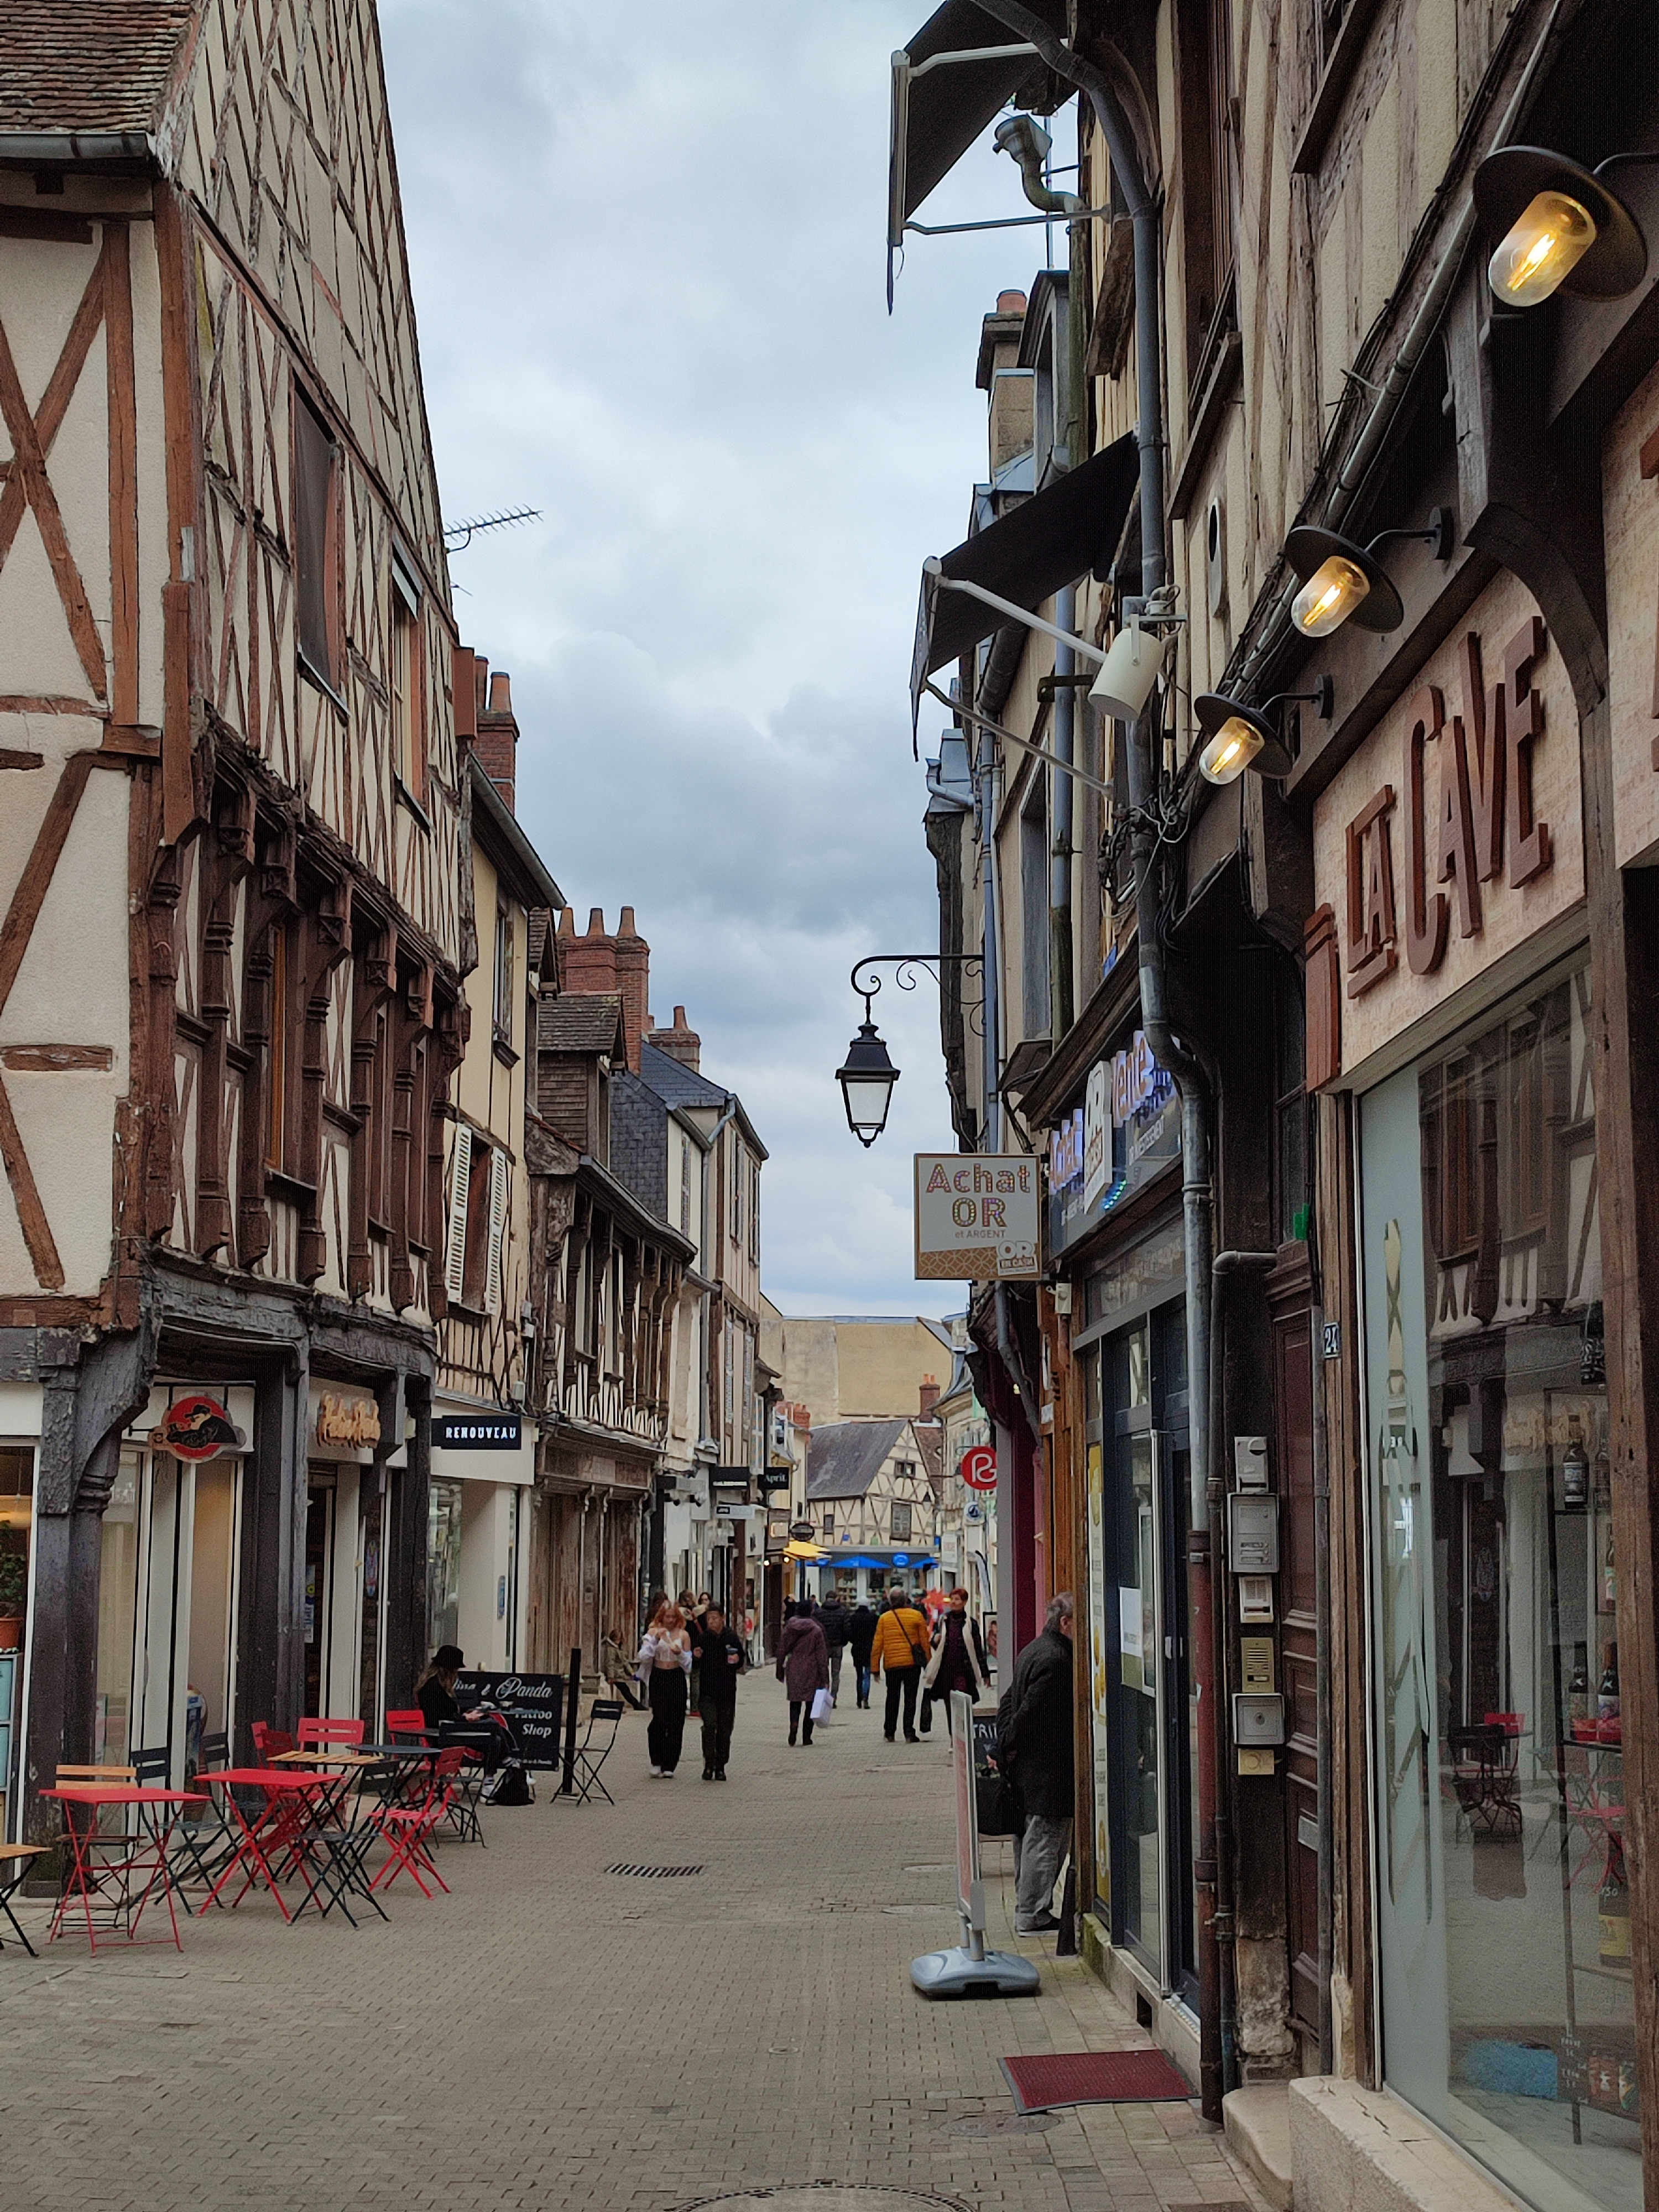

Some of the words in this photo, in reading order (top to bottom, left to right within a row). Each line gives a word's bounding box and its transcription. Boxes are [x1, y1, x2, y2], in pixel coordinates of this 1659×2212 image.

[1346, 816, 1397, 974] LA
[1403, 615, 1553, 976] CAVE
[926, 1162, 1031, 1193] Achat
[952, 1197, 1008, 1228] OR
[954, 1230, 964, 1239] et
[966, 1230, 1006, 1239] ARGENT
[998, 1240, 1034, 1259] OR
[1325, 1327, 1337, 1353] 24
[446, 1427, 517, 1439] RENOUVEAU
[495, 1677, 552, 1699] Panda
[521, 1723, 552, 1739] Shop
